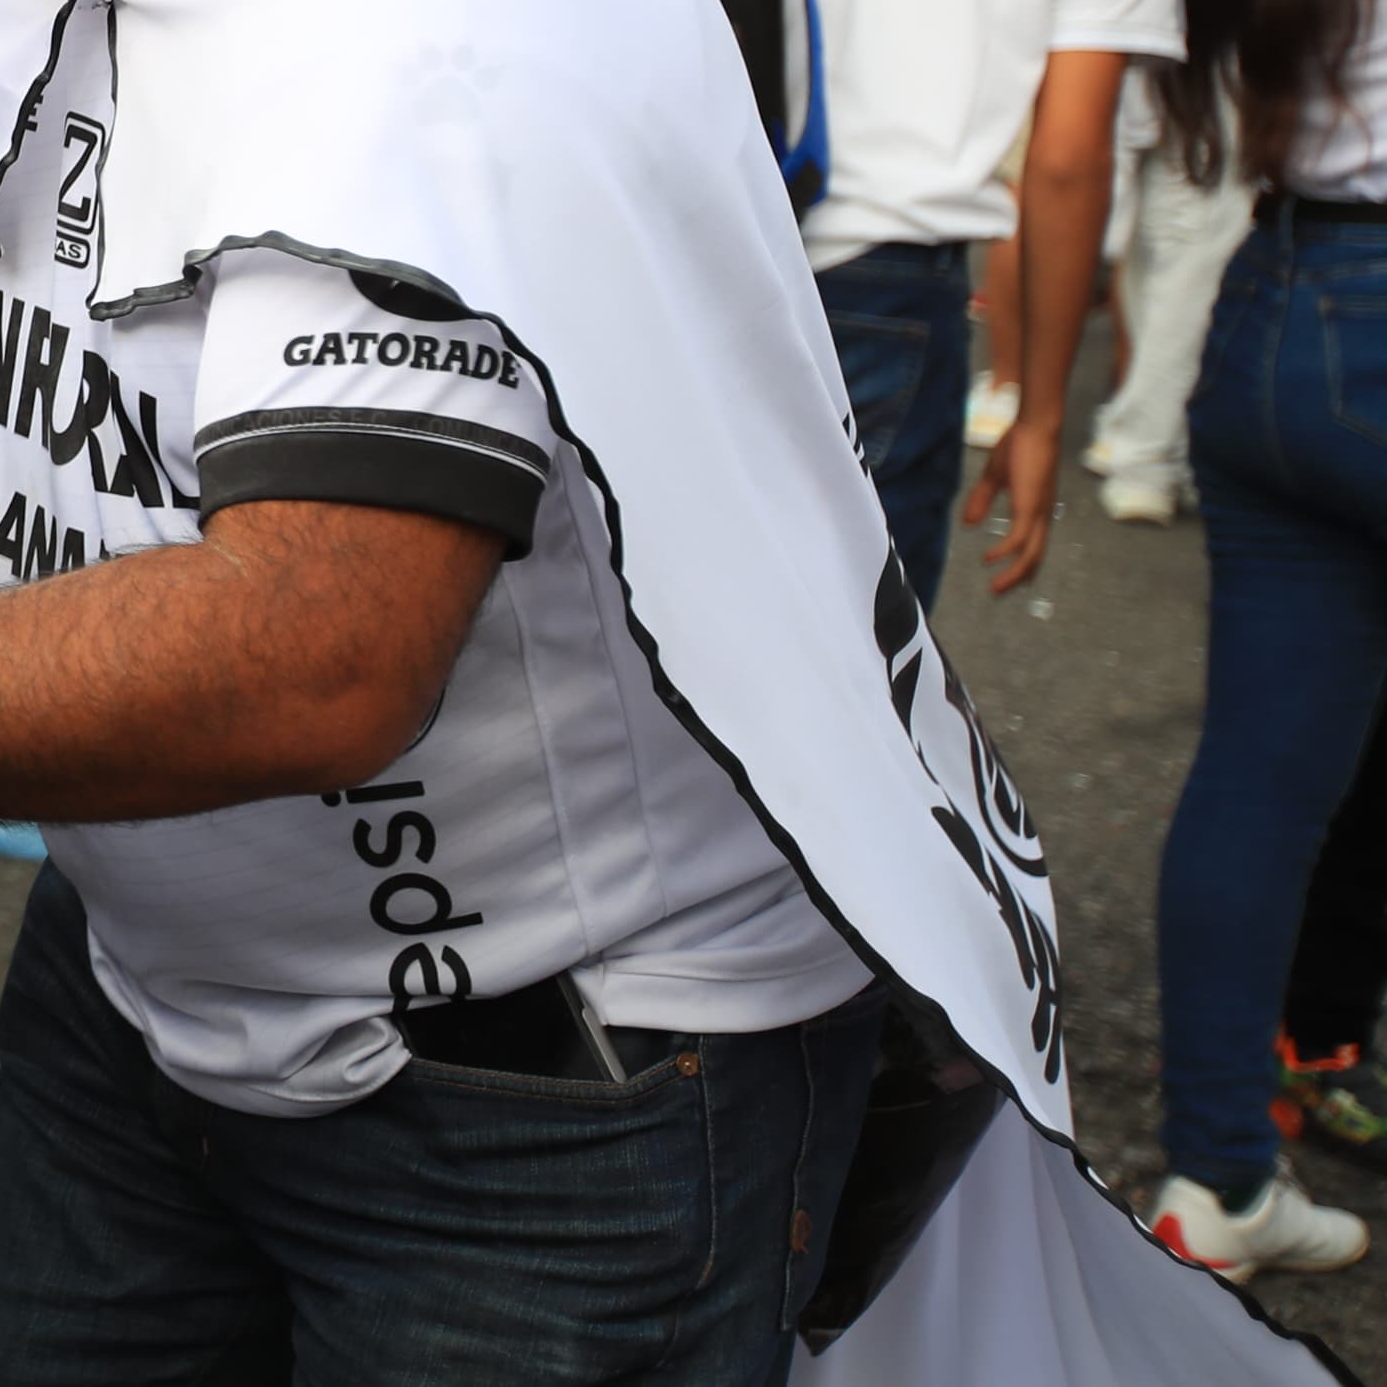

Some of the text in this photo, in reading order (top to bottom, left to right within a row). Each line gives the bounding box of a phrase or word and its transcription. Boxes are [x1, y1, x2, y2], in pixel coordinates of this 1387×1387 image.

[58, 123, 98, 222] Z
[55, 237, 82, 260] AS
[283, 331, 521, 390] GATORADE
[321, 780, 484, 1016] epsi
